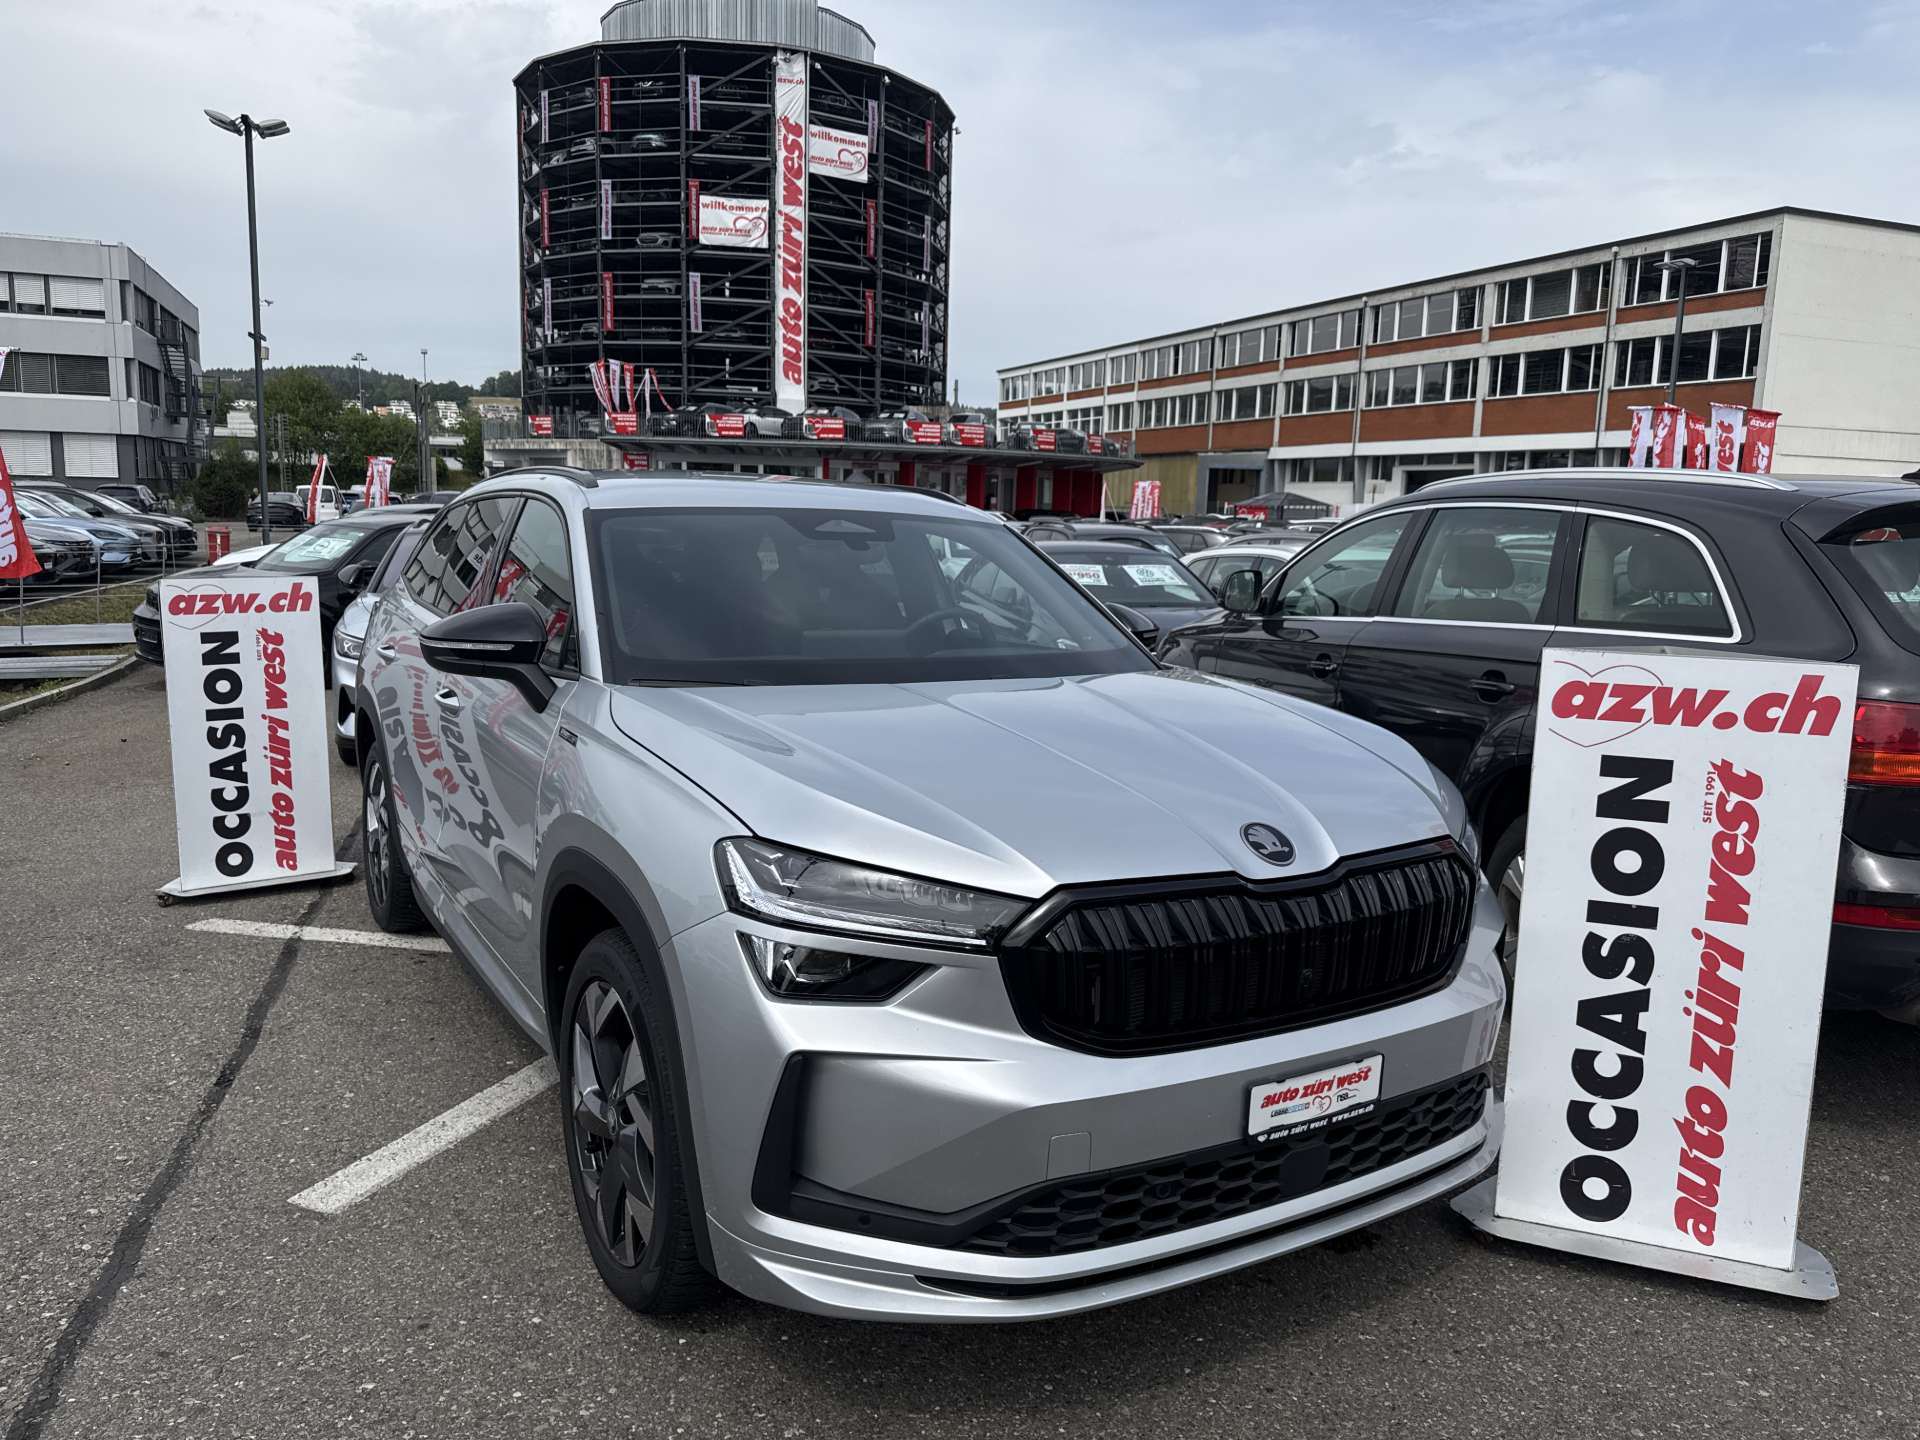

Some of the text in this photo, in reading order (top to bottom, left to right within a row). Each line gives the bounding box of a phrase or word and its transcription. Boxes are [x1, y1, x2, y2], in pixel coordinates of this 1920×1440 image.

[810, 131, 866, 148] willkommen
[701, 200, 767, 213] willkommen
[778, 115, 803, 385] auto züri west
[168, 583, 313, 615] azw.ch
[1552, 675, 1841, 737] azw.ch
[200, 631, 254, 877] OCCASION
[257, 628, 298, 871] auto züri west
[1702, 770, 1717, 824] SEIT 1991
[1560, 754, 1674, 1223] OCCASION
[1674, 759, 1764, 1246] auto züri west
[1261, 1065, 1372, 1108] auto züri west
[1269, 1128, 1289, 1140] auto
[1309, 1118, 1329, 1131] west
